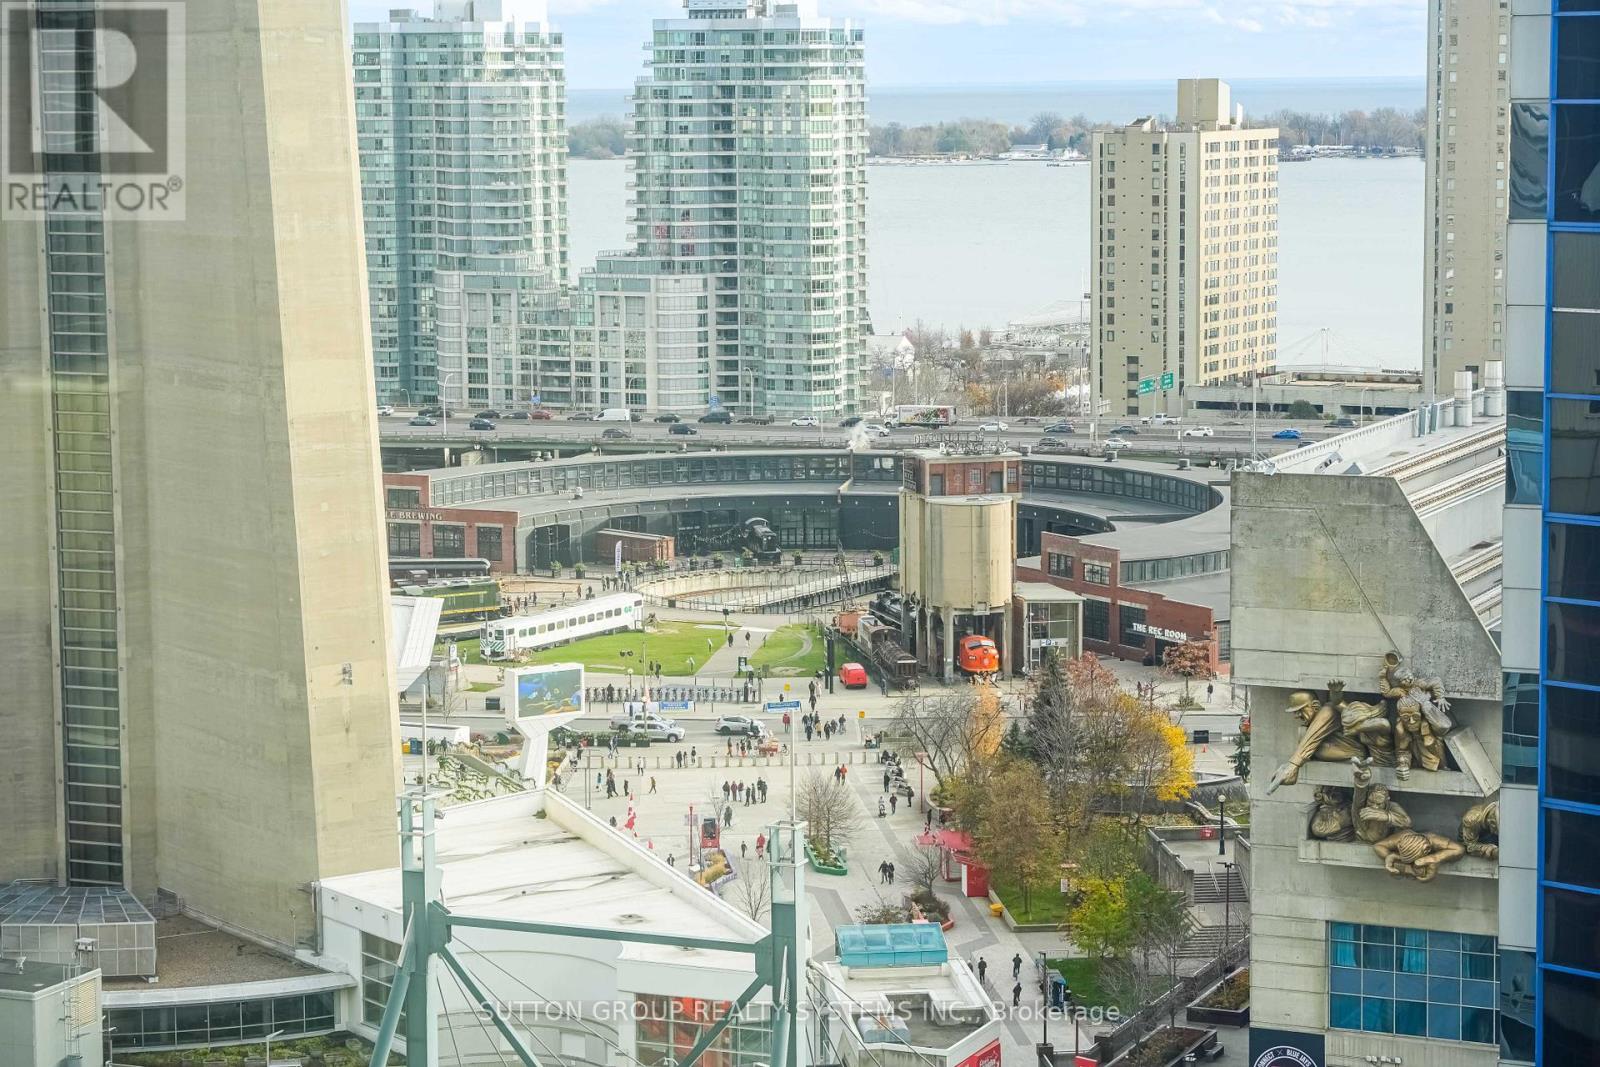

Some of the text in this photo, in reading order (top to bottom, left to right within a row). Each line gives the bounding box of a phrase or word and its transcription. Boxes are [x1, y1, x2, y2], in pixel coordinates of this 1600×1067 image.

[399, 511, 442, 520] BREWING
[1132, 622, 1147, 633] THE
[1148, 626, 1163, 636] REC
[1164, 628, 1187, 641] ROOM
[1286, 1048, 1301, 1059] BLUE
